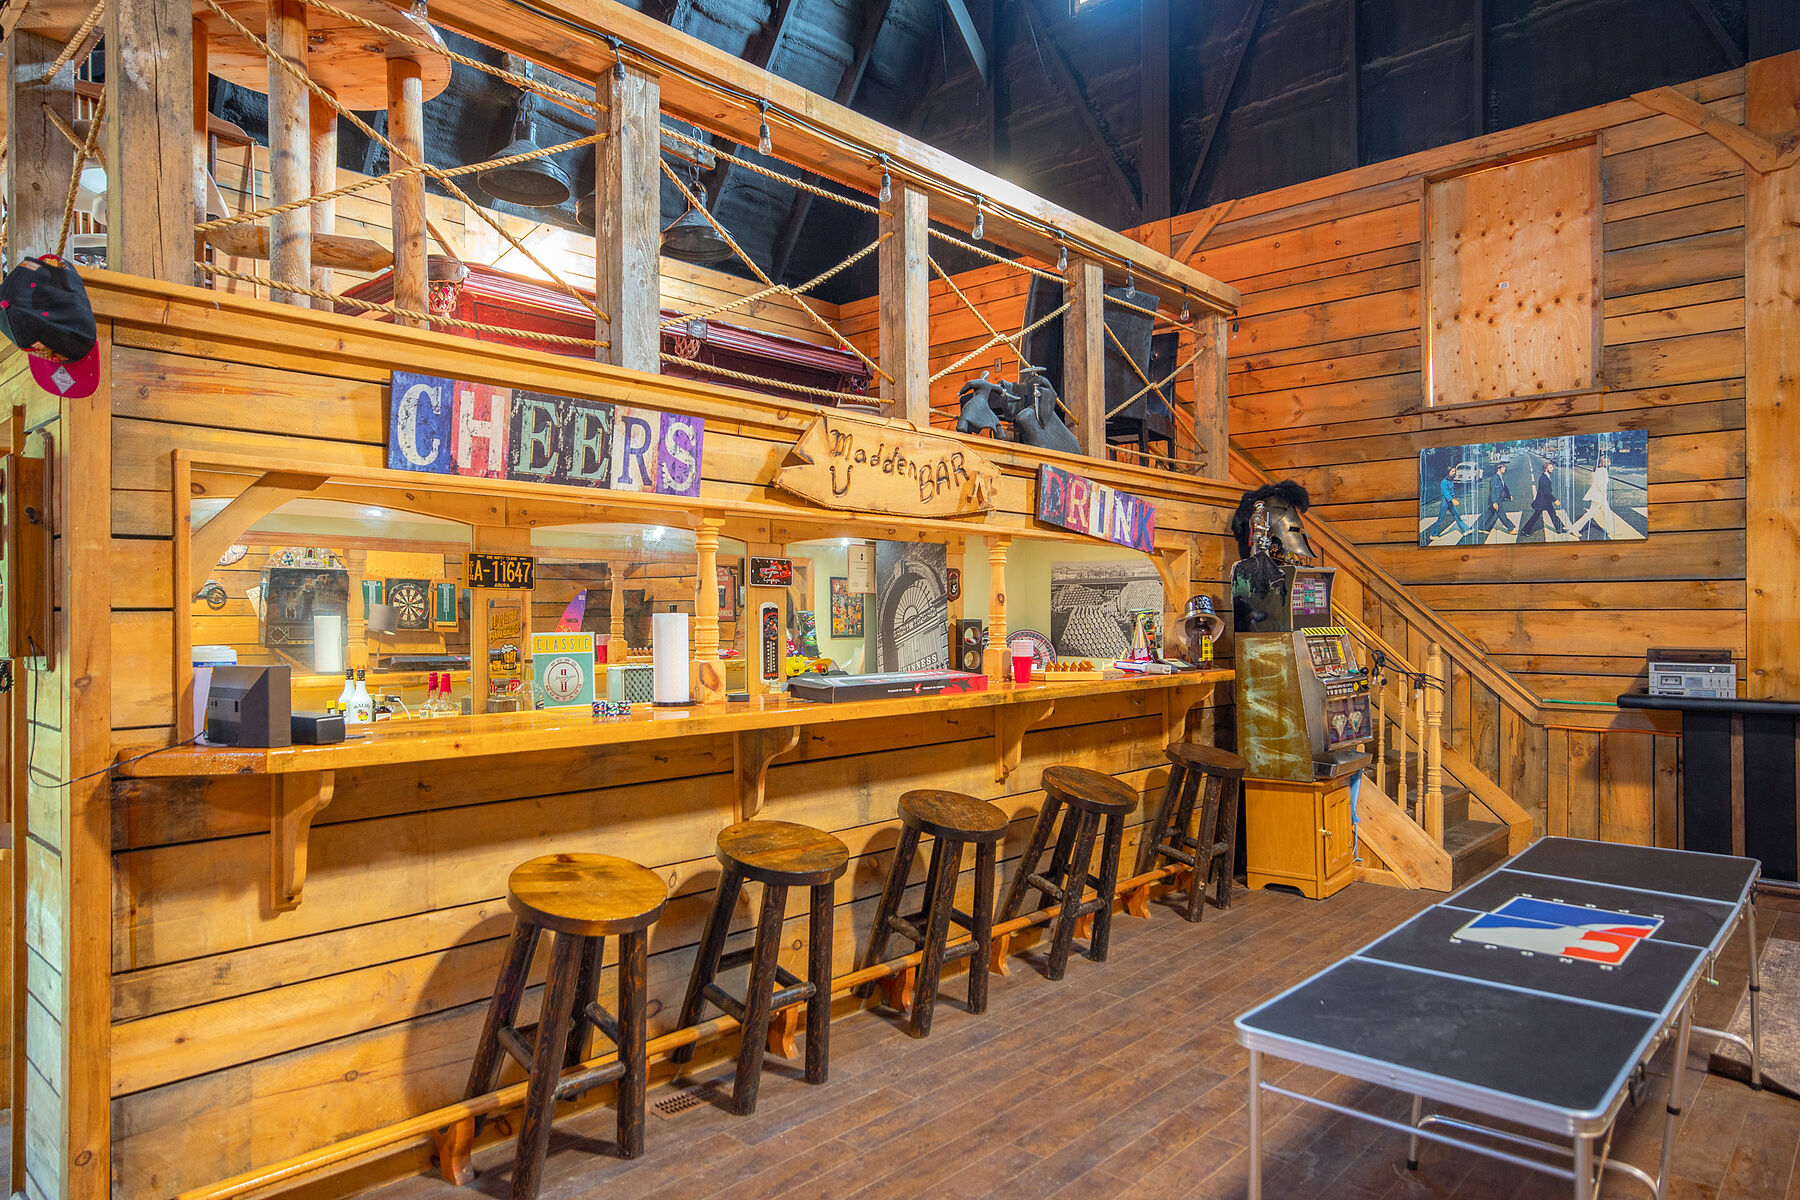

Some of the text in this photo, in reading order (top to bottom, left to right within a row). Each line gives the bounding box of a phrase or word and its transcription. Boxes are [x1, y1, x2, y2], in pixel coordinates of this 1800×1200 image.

[397, 383, 696, 492] CHEERS
[919, 452, 970, 504] BAR
[1043, 470, 1155, 551] DRINK
[474, 560, 531, 583] A-11647
[537, 638, 590, 651] CLASSIC
